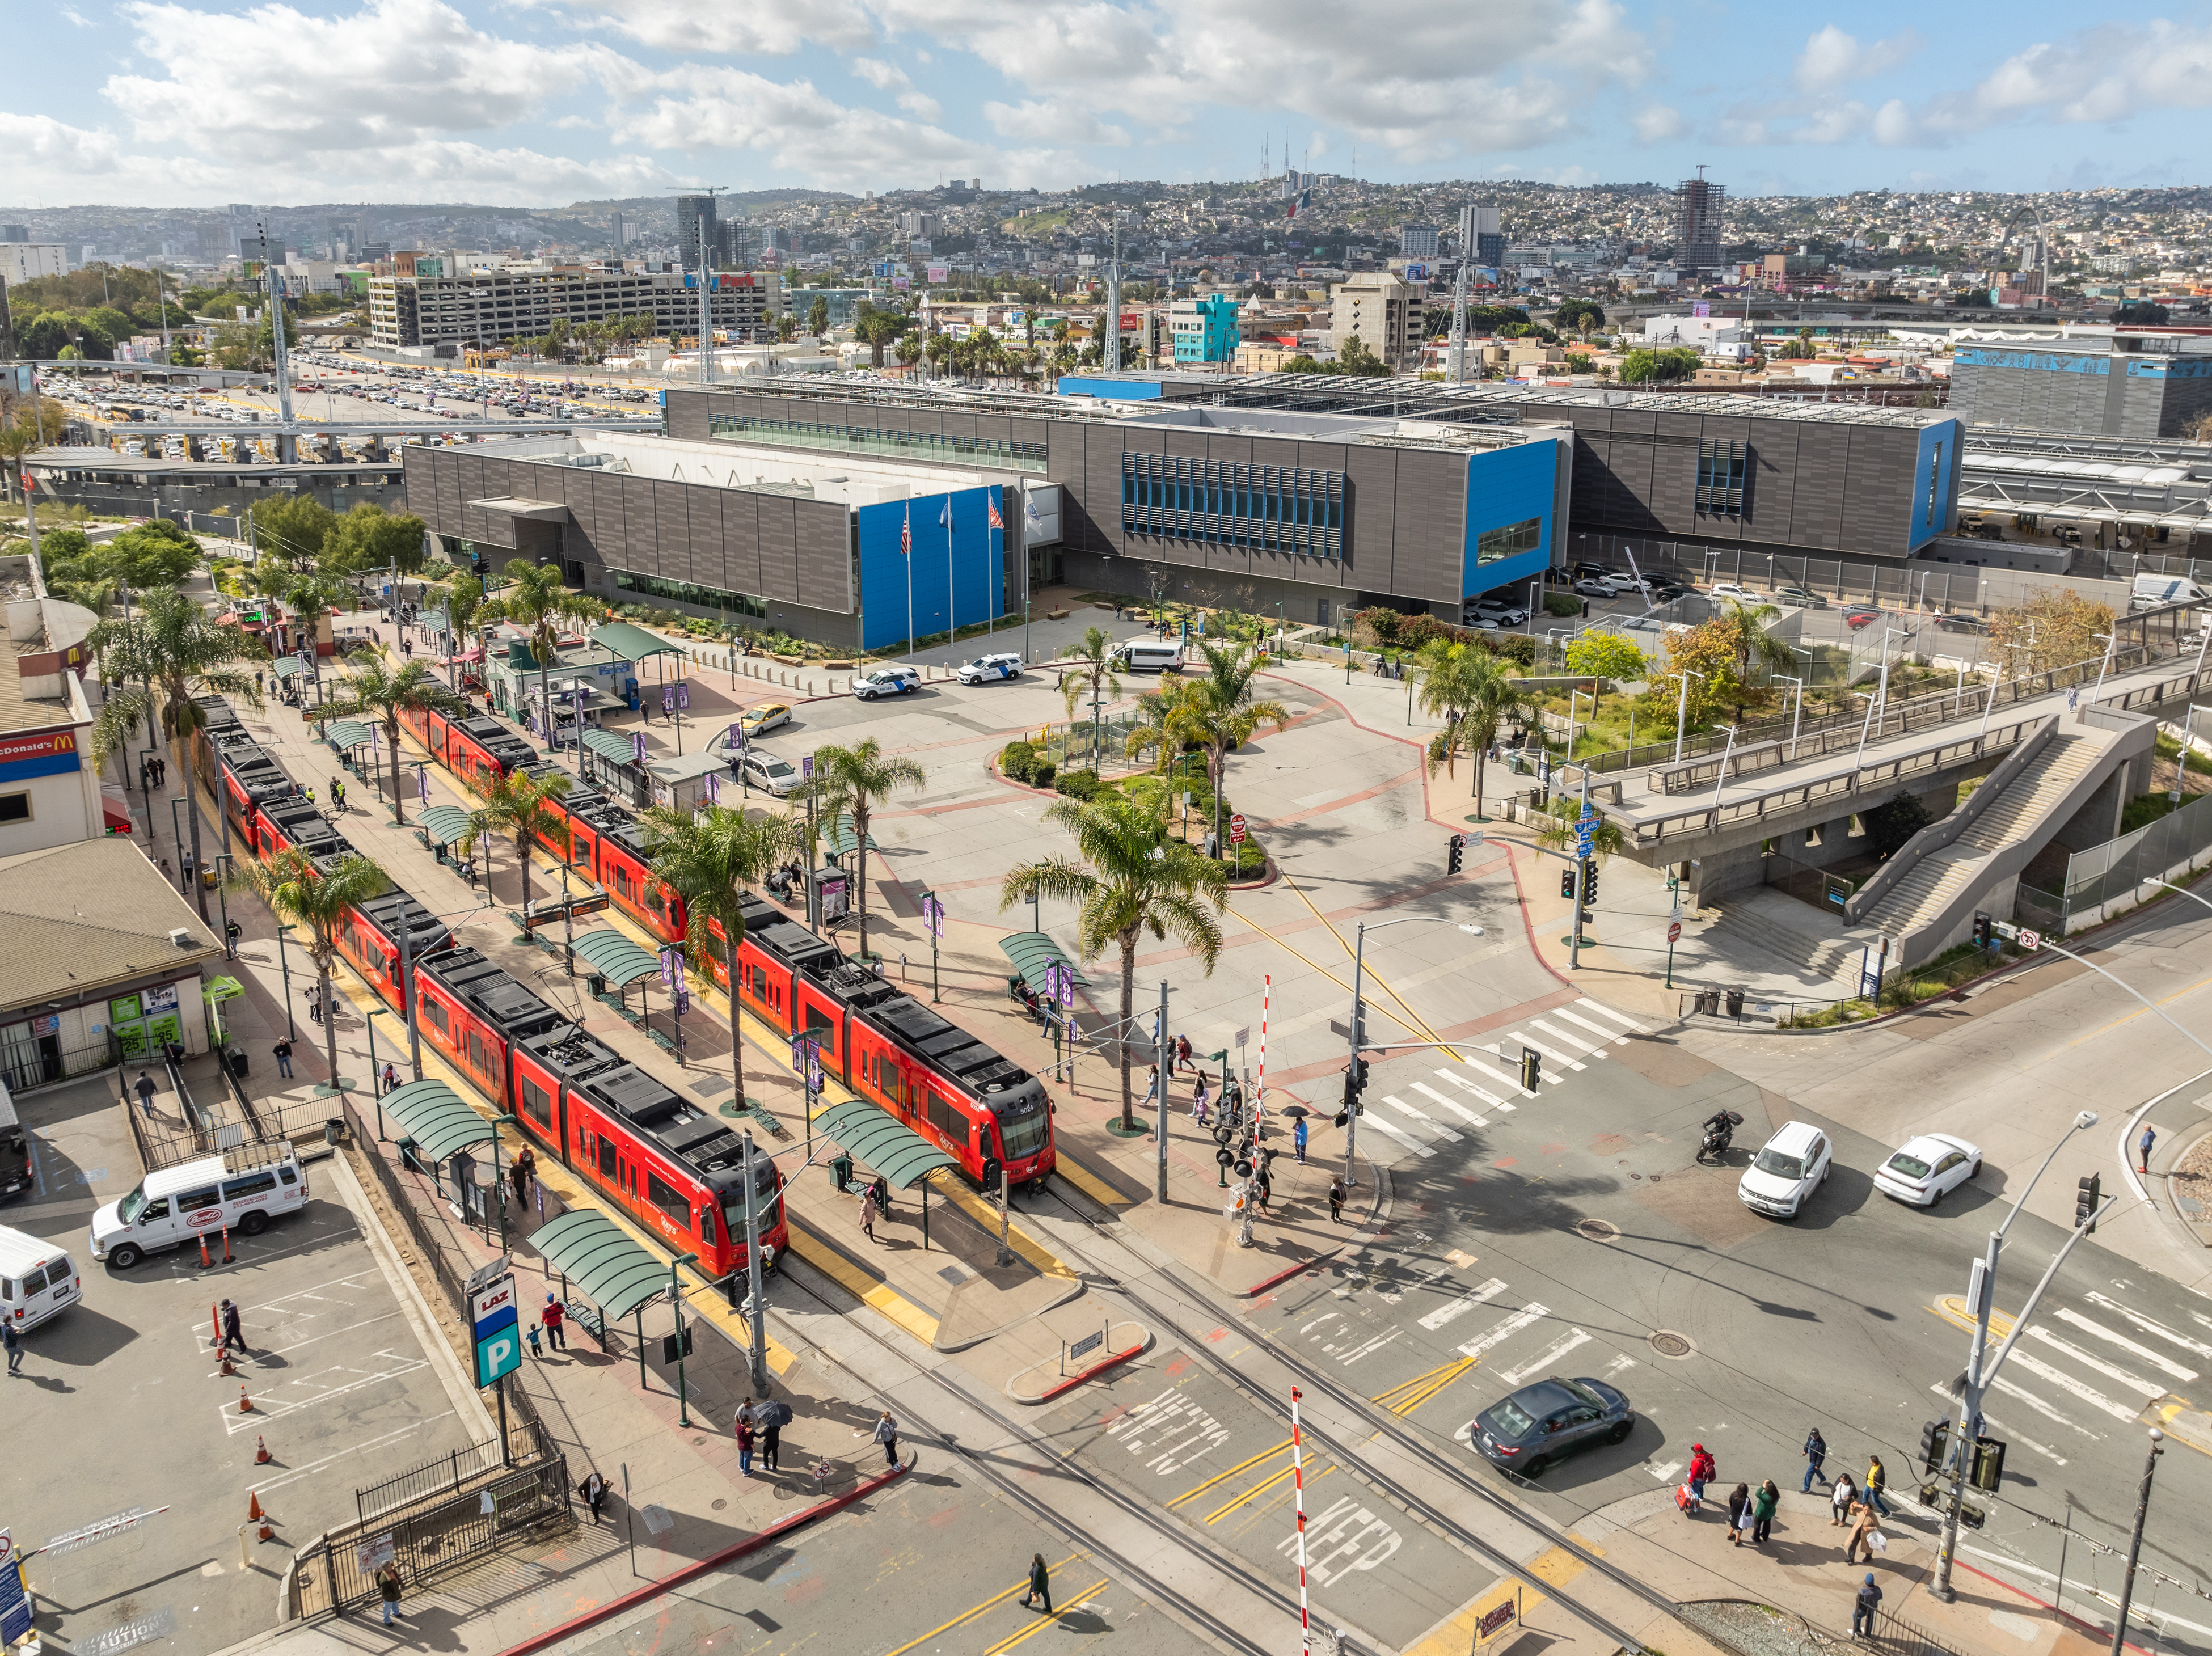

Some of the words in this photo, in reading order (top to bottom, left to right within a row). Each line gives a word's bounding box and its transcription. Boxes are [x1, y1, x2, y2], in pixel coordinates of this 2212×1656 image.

[685, 274, 719, 291] Eay
[720, 273, 755, 287] Park
[0, 742, 52, 755] cDonald's
[153, 1023, 175, 1032] UNLIMITED
[1020, 1104, 1034, 1115] 5024
[939, 1133, 954, 1151] MTS
[691, 1184, 701, 1194] 4012
[233, 1193, 269, 1206] RESERVACIONES
[661, 1215, 676, 1234] MTS
[482, 1290, 508, 1312] LAZ
[487, 1339, 511, 1378] P
[1107, 1387, 1232, 1476] CLEAR
[83, 1516, 119, 1532] PEDESTRIAN
[51, 1529, 81, 1542] WALKWAY
[1275, 1496, 1403, 1587] KEEP
[0, 1565, 15, 1576] KING
[0, 1573, 12, 1582] ATES
[86, 1620, 160, 1653] CAUTION
